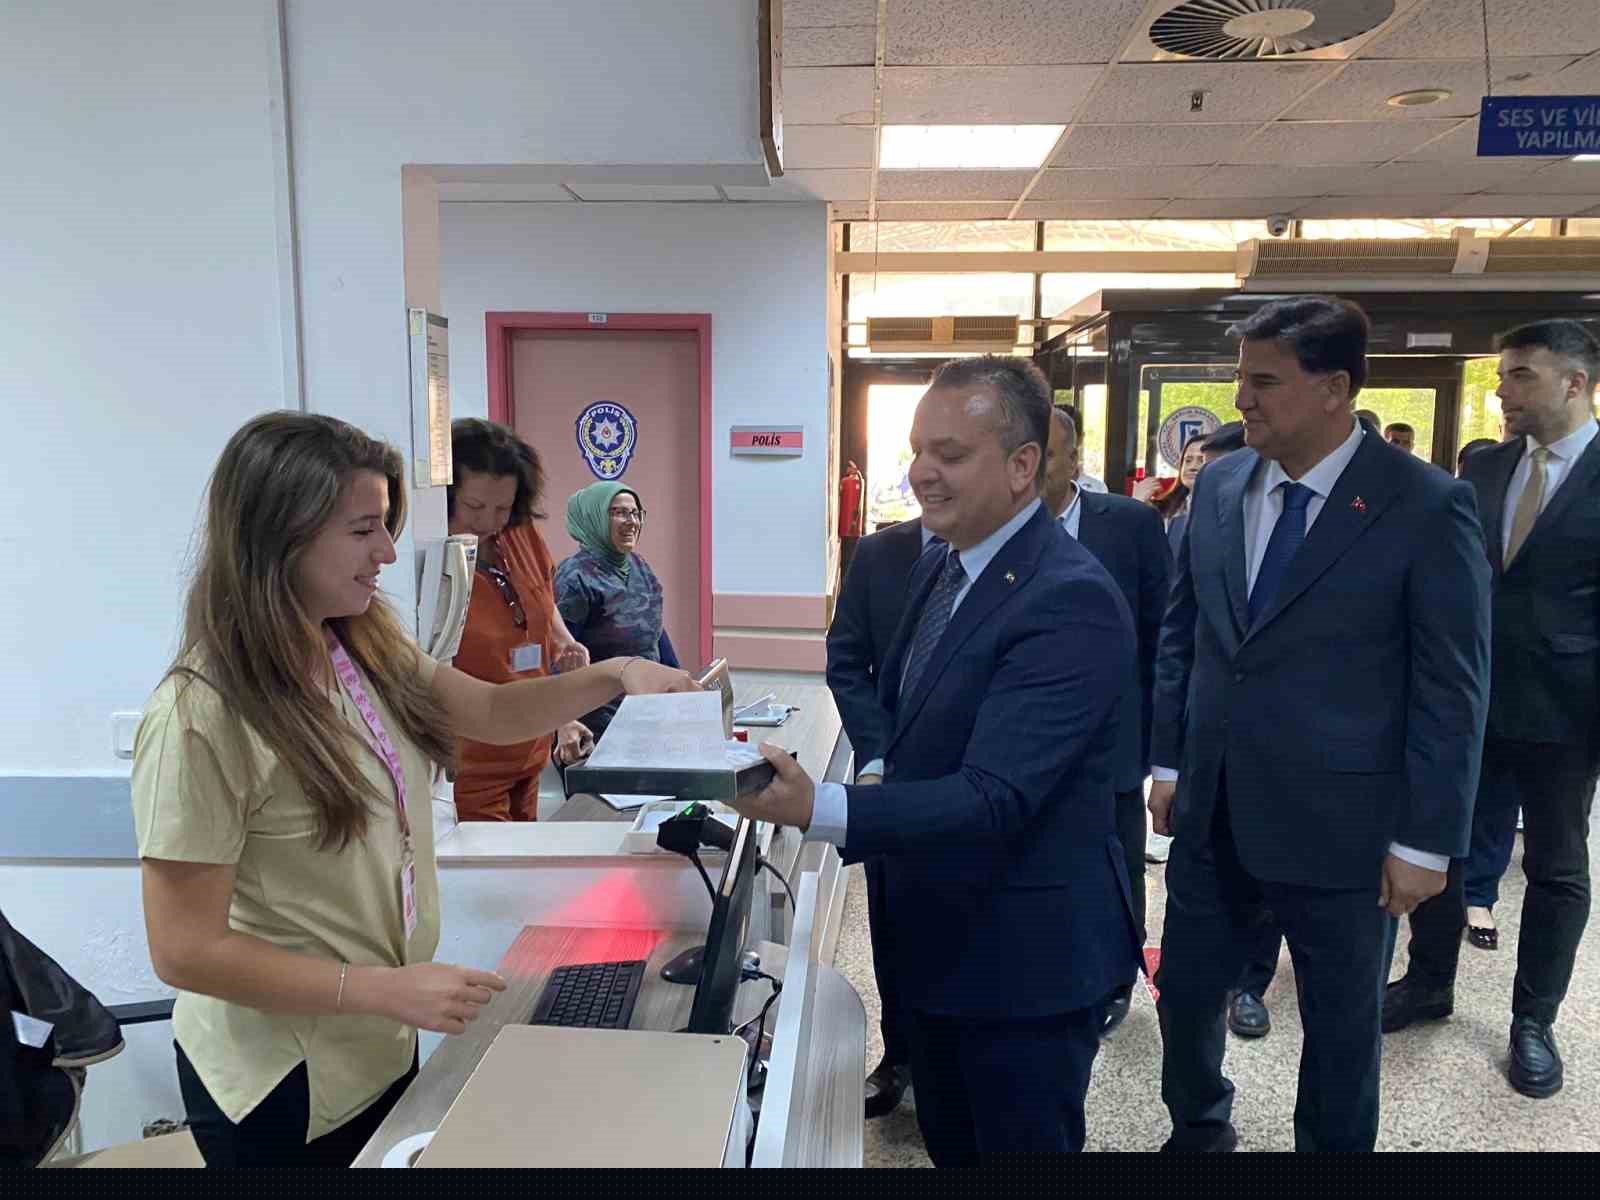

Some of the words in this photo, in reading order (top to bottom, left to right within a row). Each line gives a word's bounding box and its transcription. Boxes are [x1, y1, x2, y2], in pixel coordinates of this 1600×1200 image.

[1498, 109, 1535, 128] SES
[1541, 108, 1568, 127] VE
[751, 432, 782, 446] POLİS
